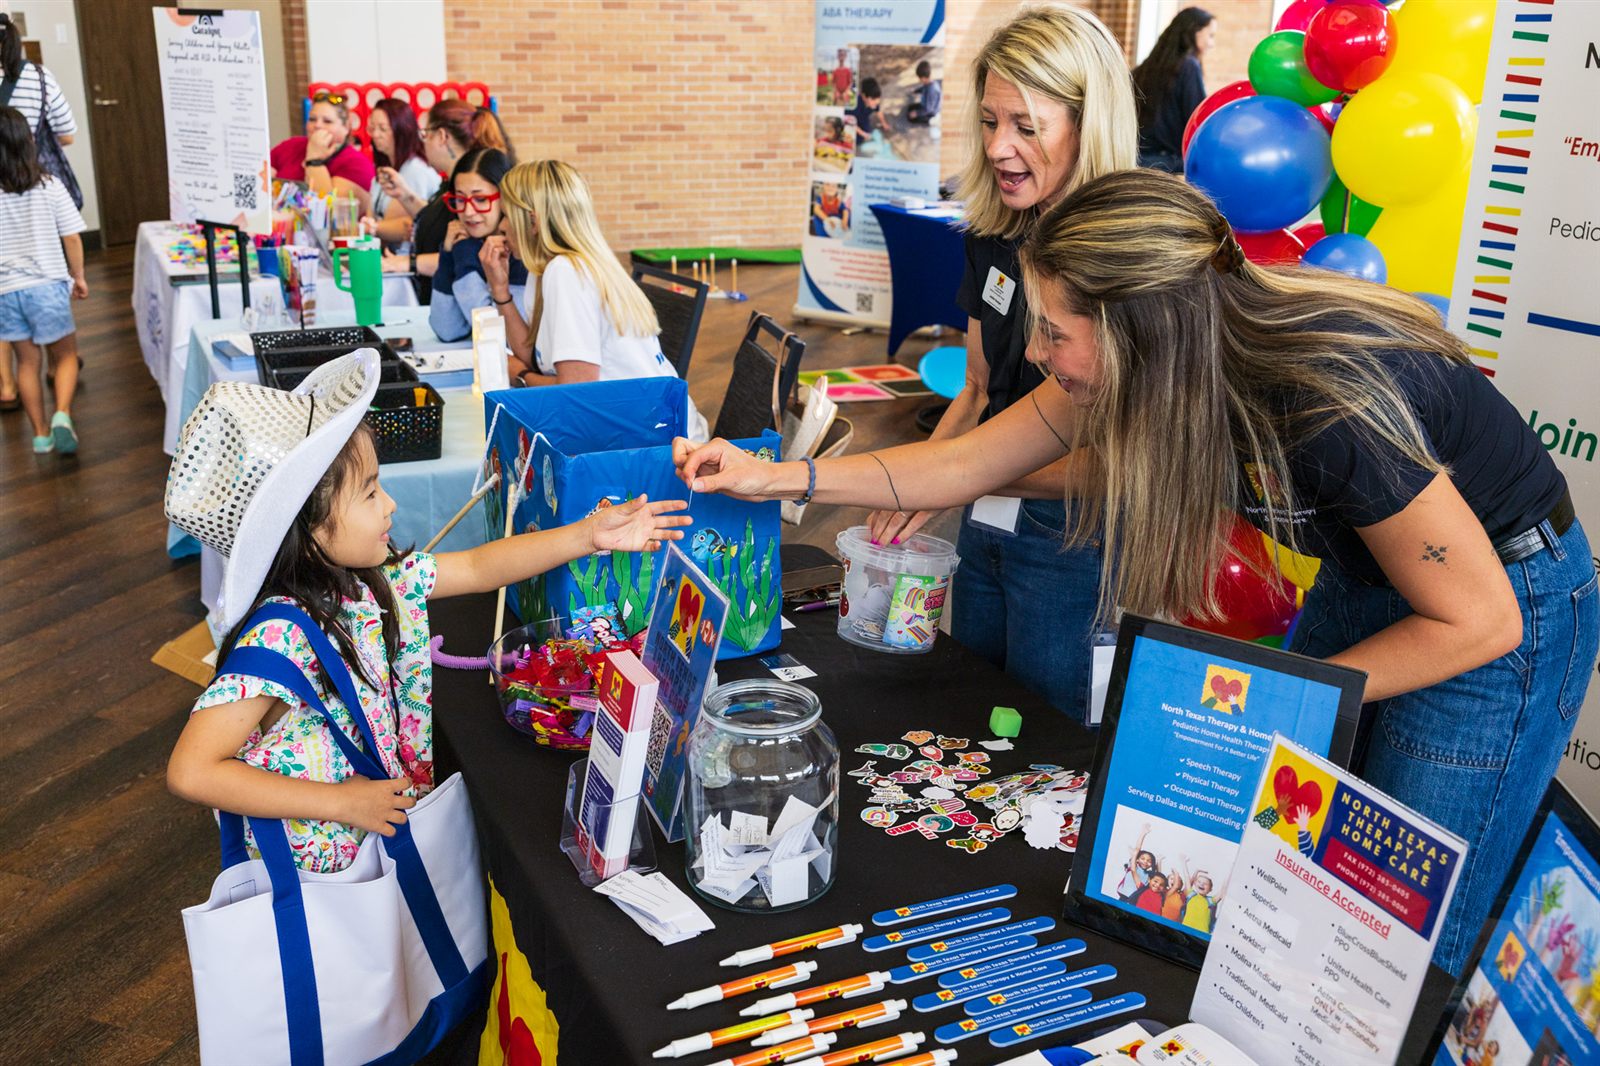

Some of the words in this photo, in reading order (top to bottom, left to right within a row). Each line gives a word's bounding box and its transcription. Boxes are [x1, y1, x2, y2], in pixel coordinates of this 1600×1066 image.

[822, 7, 842, 18] ABA
[845, 7, 893, 18] THERAPY
[1161, 702, 1184, 716] North
[1186, 710, 1206, 722] Texas
[1208, 716, 1239, 732] Therapy
[1240, 726, 1246, 734] &
[1248, 728, 1272, 741] Home
[1172, 720, 1200, 733] Pediatric
[1200, 728, 1220, 739] Home
[1222, 734, 1242, 746] Health
[1230, 748, 1246, 758] Better
[1186, 758, 1212, 772] Speech
[1212, 766, 1242, 782] Therapy
[1182, 772, 1210, 786] Physical
[1211, 781, 1240, 798] Therapy
[1128, 786, 1154, 802] Serving
[1156, 795, 1178, 808] Dallas
[1178, 804, 1193, 813] and
[1194, 808, 1240, 830] Surrounding
[1170, 784, 1216, 804] Occupational
[1216, 798, 1246, 815] Therapy
[1341, 792, 1390, 829] NORTH
[1398, 828, 1448, 865] TEXAS
[1348, 812, 1414, 859] THERAPY
[1422, 860, 1431, 872] &
[1341, 824, 1381, 856] HOME
[1388, 855, 1429, 887] CARE
[1343, 852, 1357, 865] FAX
[1358, 858, 1376, 878] (972)
[1256, 867, 1288, 896] WellPoint
[1336, 862, 1359, 882] PHONE
[1360, 876, 1377, 894] (972)
[941, 896, 964, 904] Therapy
[1251, 888, 1278, 912] Superior
[1275, 849, 1331, 895] Insurance
[1332, 890, 1392, 938] Accepted
[934, 920, 956, 929] Therapy
[979, 930, 1000, 938] Therapy
[1244, 908, 1262, 926] Aetna
[1262, 922, 1292, 949] Medicaid
[959, 949, 982, 959] Therapy
[1238, 928, 1266, 954] Parkland
[1334, 936, 1350, 952] PPO
[1337, 926, 1408, 981] BlueCrossBlueShield
[1008, 954, 1030, 964] Therapy
[1230, 946, 1252, 968] Molina
[1252, 964, 1282, 992] Medicaid
[986, 976, 1010, 985] Therapy
[1037, 980, 1060, 990] Therapy
[1324, 966, 1340, 982] PPO
[1327, 956, 1350, 978] United
[1350, 973, 1374, 996] Health
[1374, 992, 1392, 1008] Care
[1218, 986, 1235, 1004] Cook
[1225, 966, 1258, 998] Traditional
[1258, 994, 1288, 1024] Medicaid
[1313, 996, 1335, 1016] ONLY
[1010, 1004, 1034, 1014] Therapy
[1064, 1009, 1087, 1018] Therapy
[1337, 1002, 1378, 1038] Commercial
[1304, 1025, 1322, 1045] Cigna
